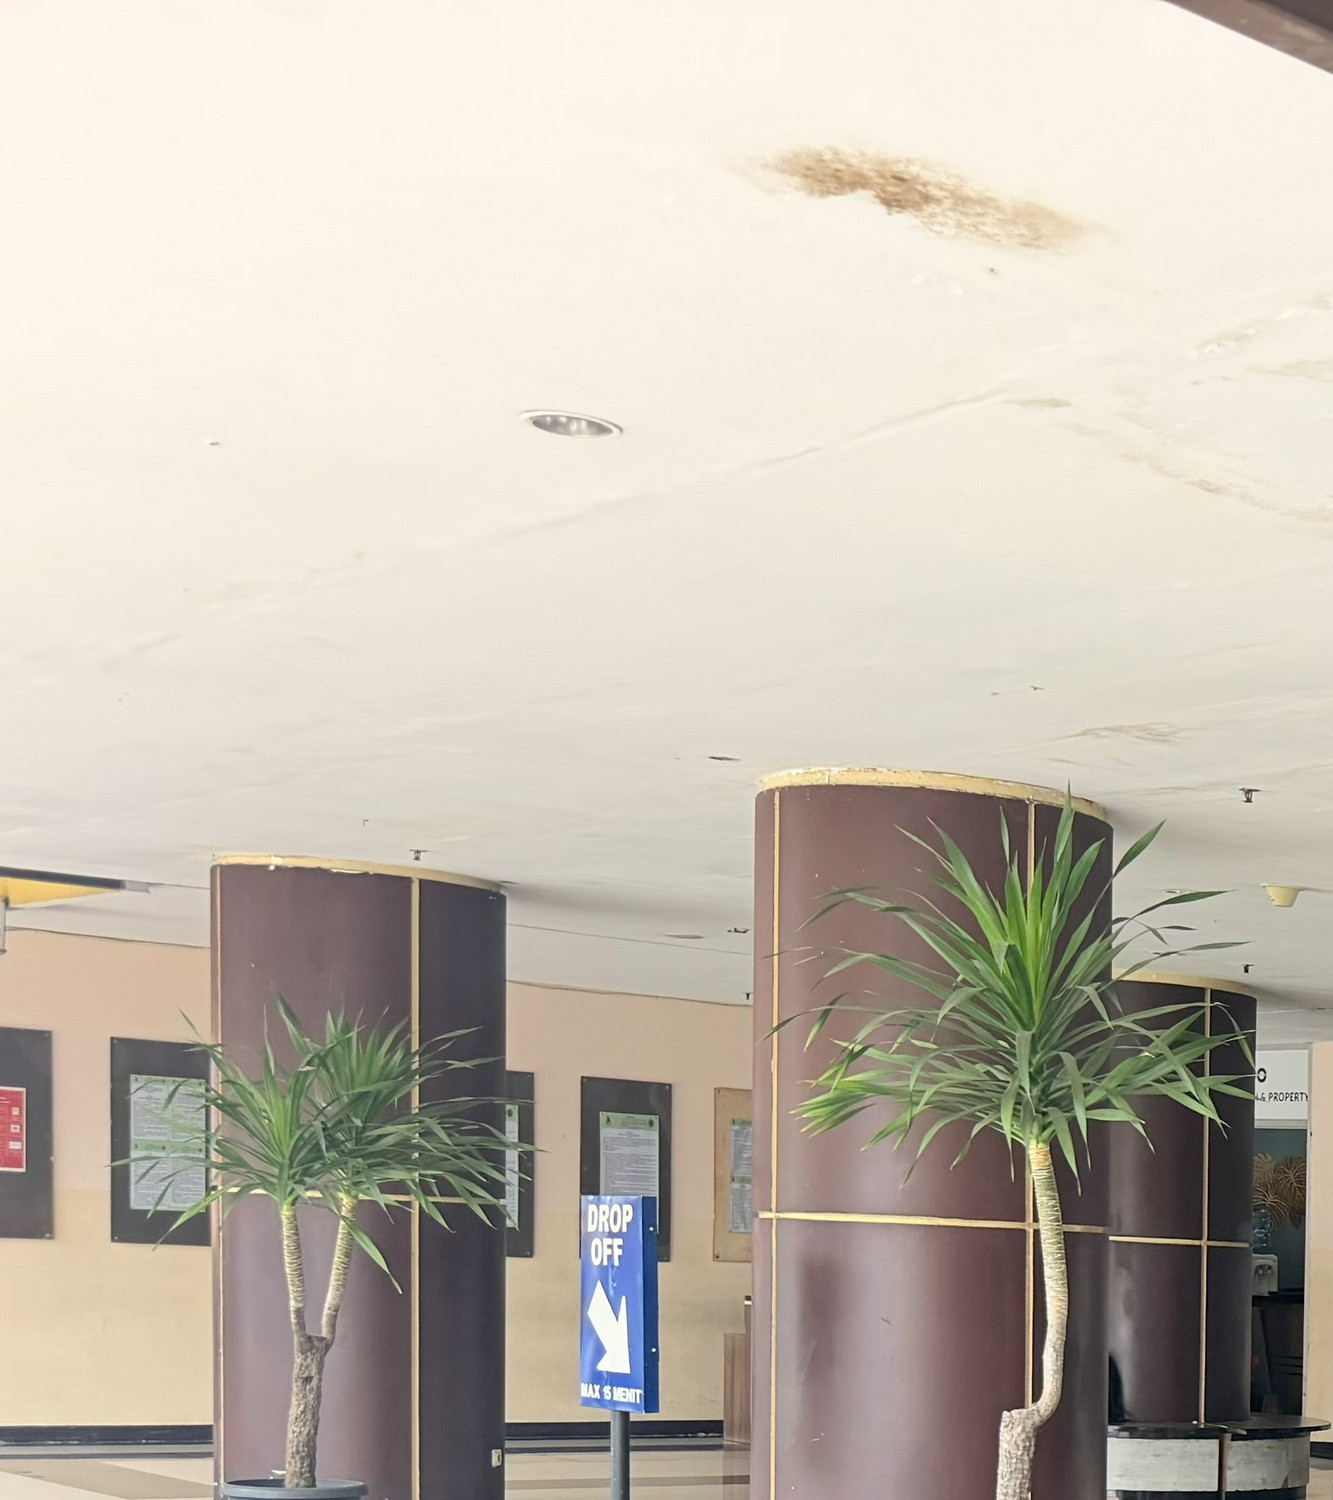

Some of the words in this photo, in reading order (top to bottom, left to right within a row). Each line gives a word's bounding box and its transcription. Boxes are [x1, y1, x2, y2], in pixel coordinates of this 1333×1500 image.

[1269, 1092, 1309, 1102] PROPERTY
[587, 1203, 633, 1233] DROP
[590, 1237, 623, 1267] OFF
[580, 1382, 600, 1400] MAX
[602, 1385, 612, 1401] 15
[613, 1386, 643, 1404] MENIT
